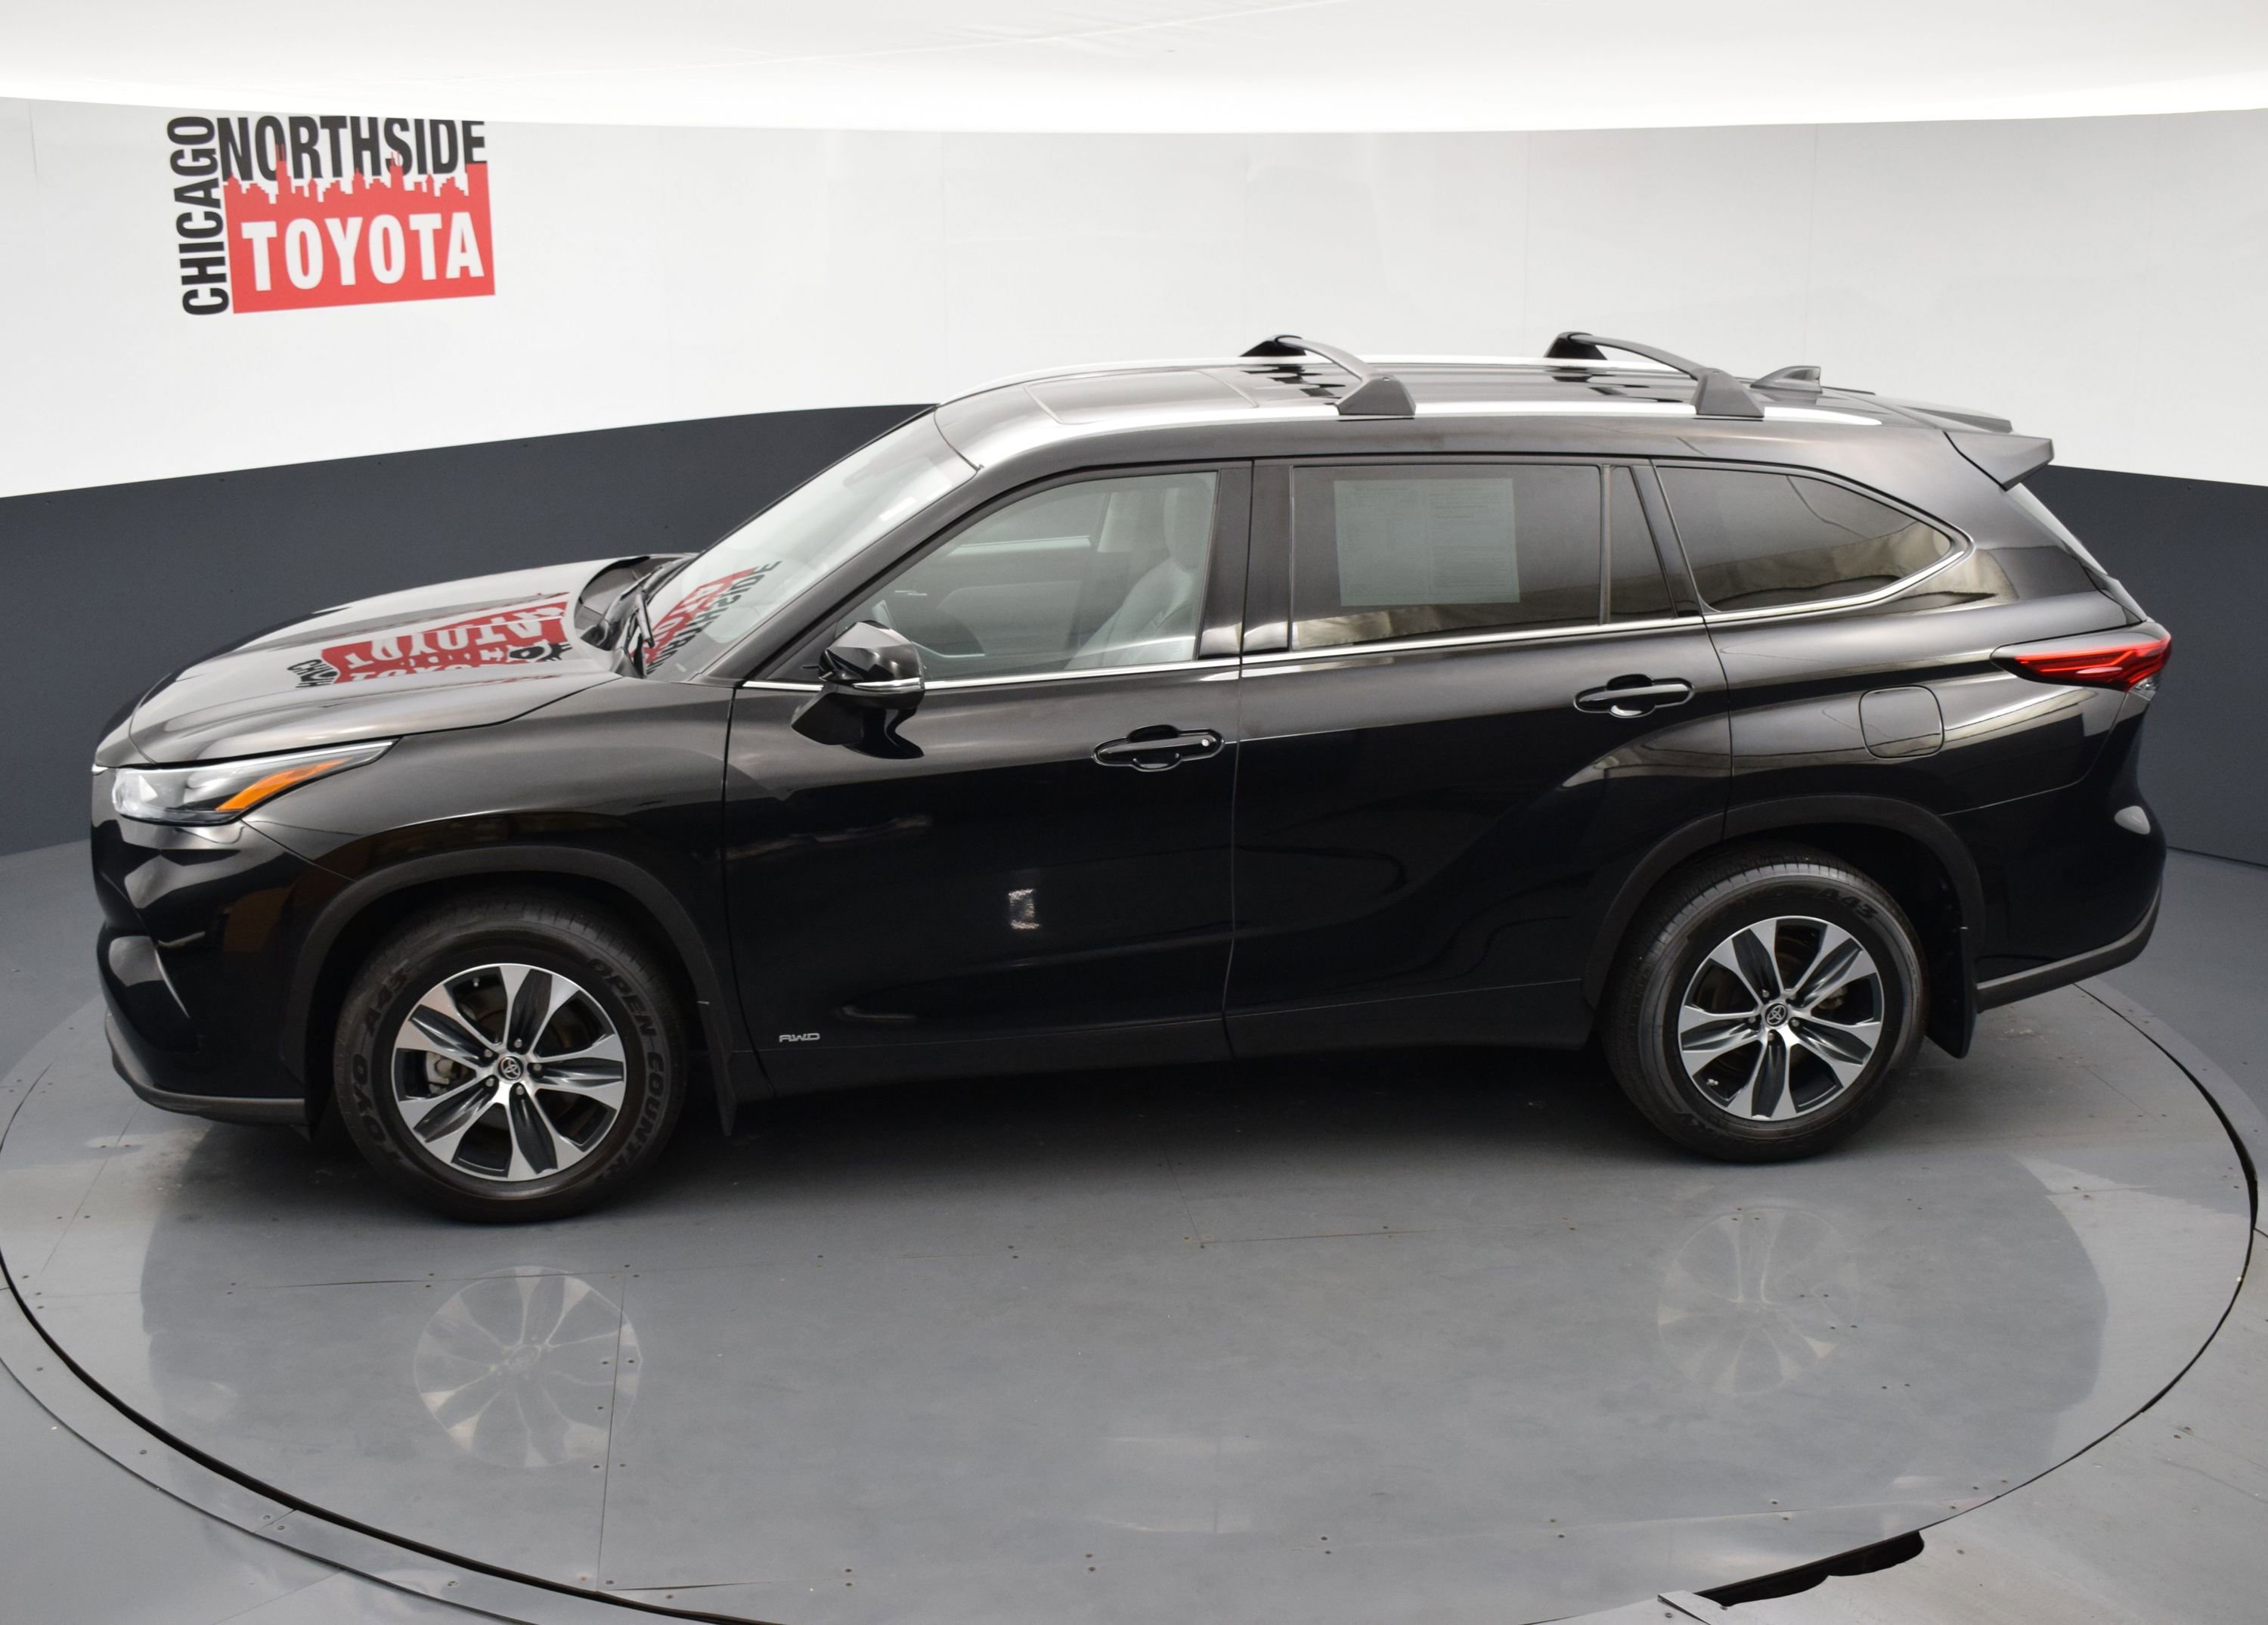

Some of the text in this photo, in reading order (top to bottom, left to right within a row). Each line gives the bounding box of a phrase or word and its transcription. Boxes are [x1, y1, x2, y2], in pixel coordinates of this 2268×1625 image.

[217, 116, 488, 181] NORTHSIDE
[167, 116, 229, 315] CHICAGO
[241, 212, 485, 292] TOYOTA
[587, 957, 656, 1036] OPEN
[779, 1033, 820, 1043] AWD
